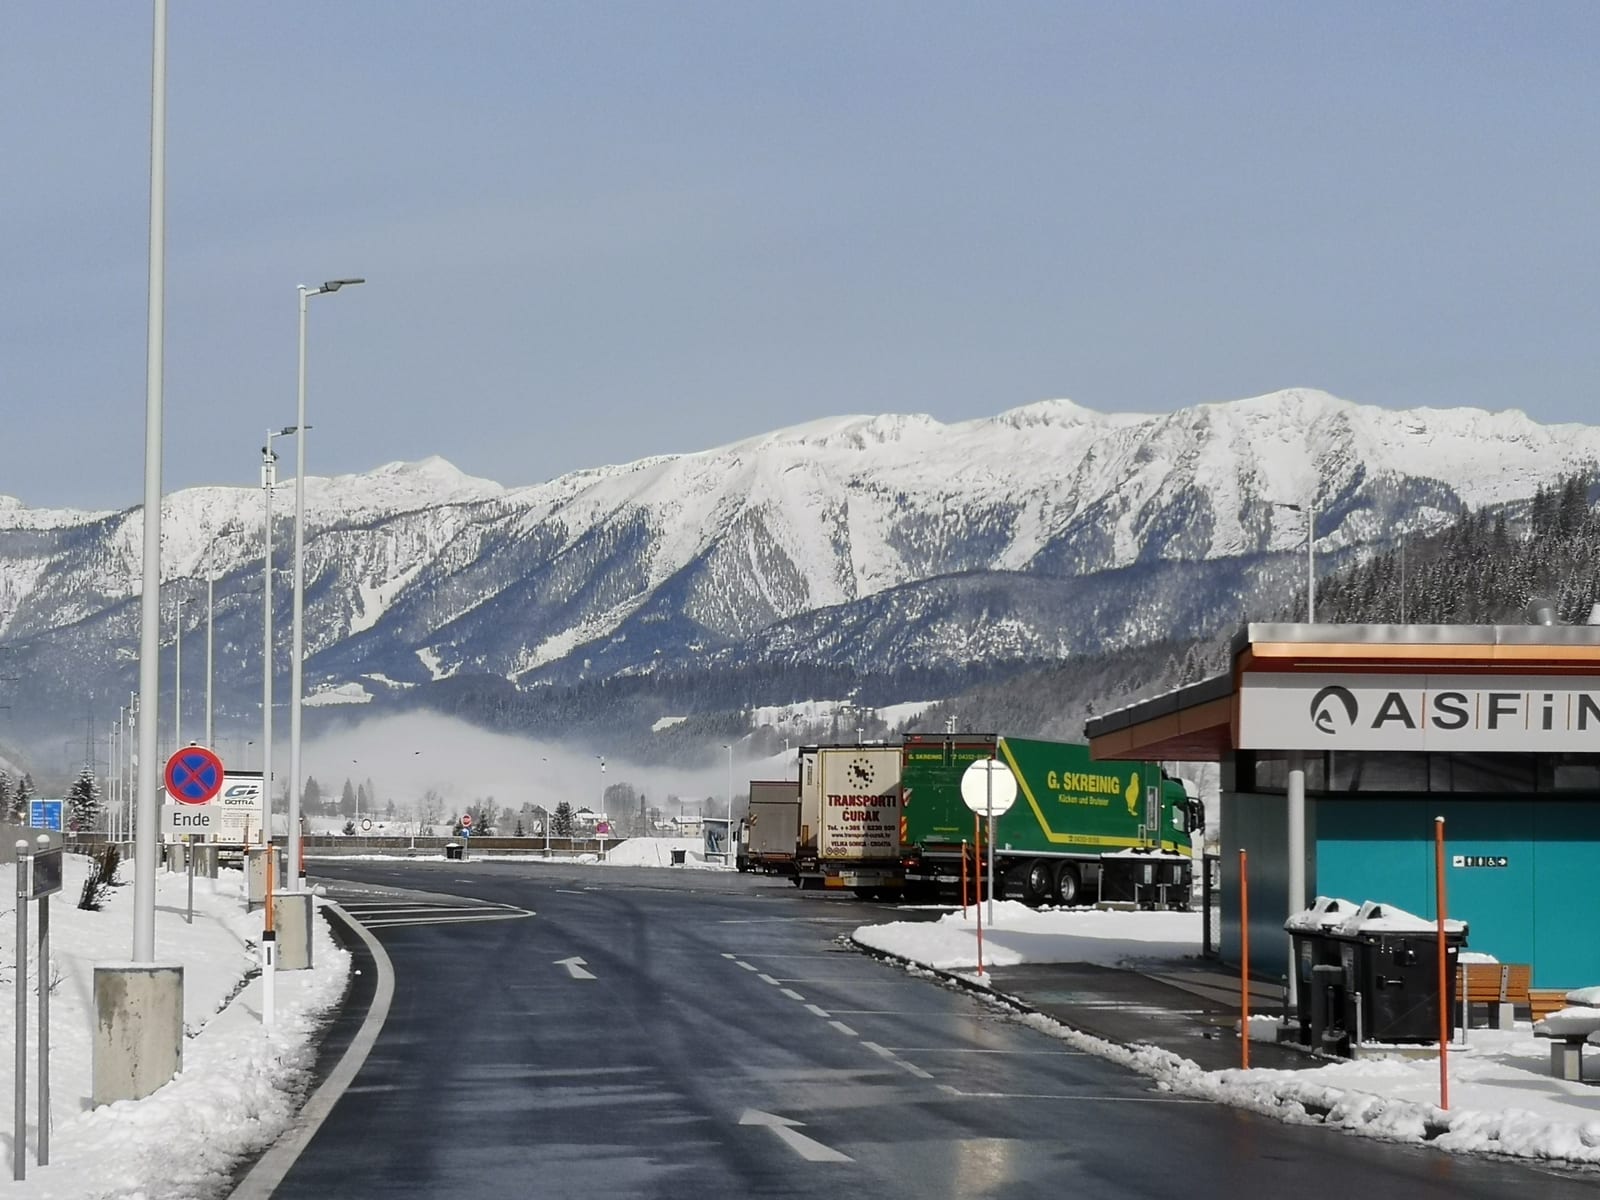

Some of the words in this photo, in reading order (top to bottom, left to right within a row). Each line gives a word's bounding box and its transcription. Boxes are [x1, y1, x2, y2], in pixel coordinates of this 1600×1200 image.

[1047, 770, 1060, 789] G.
[1063, 772, 1120, 794] SKREINIG
[827, 794, 896, 807] TRANSPORTI
[173, 812, 210, 826] Ende
